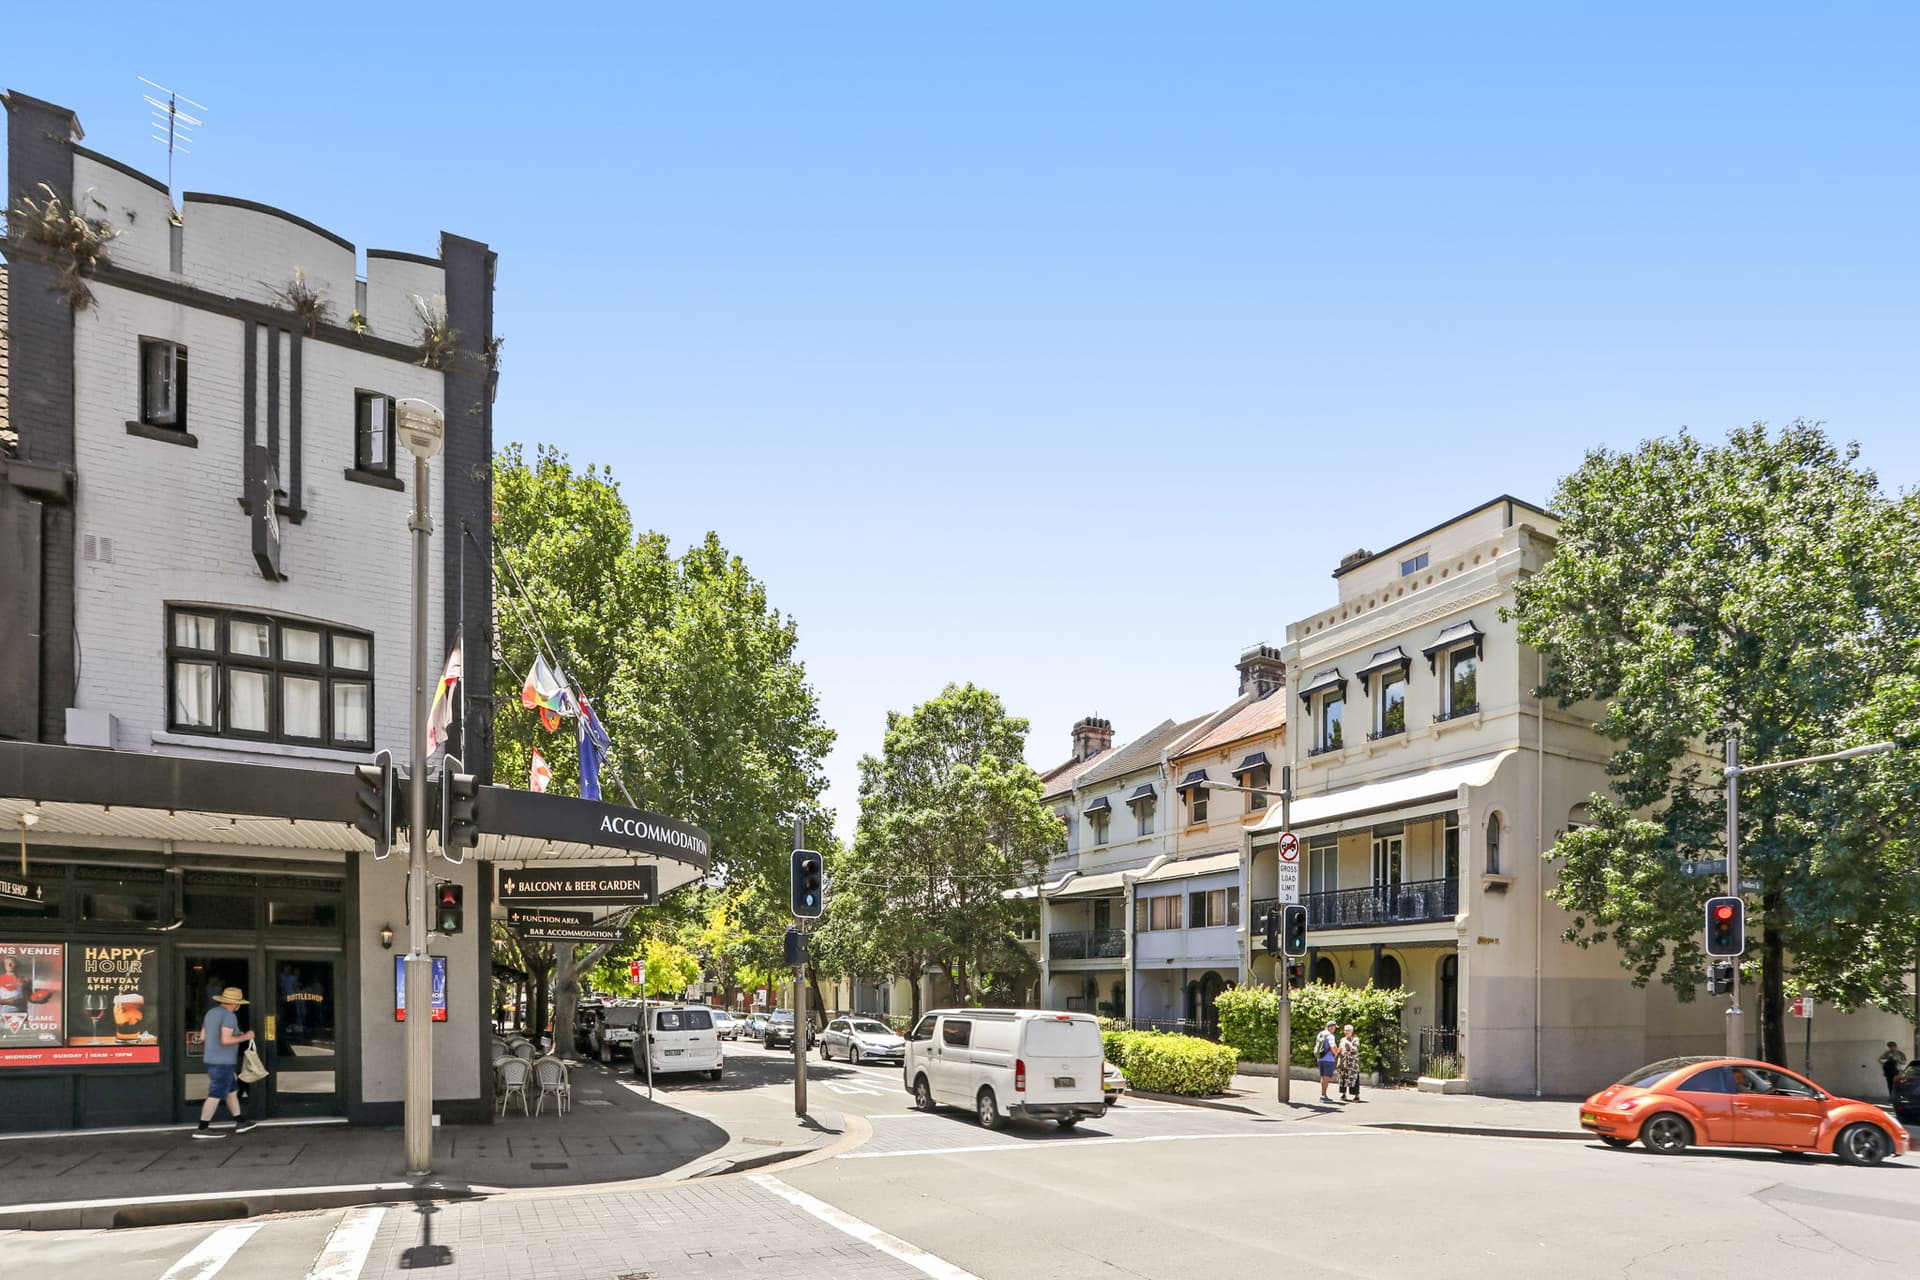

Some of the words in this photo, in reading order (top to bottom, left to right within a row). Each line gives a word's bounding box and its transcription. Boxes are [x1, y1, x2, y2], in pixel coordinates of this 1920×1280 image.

[600, 815, 707, 856] ACCOMMODATION
[11, 883, 28, 897] SHOP
[518, 881, 563, 892] BALCONY
[564, 881, 572, 891] &
[574, 880, 597, 891] BEER
[599, 880, 641, 891] GARDEN
[522, 914, 560, 924] FUNCTION
[562, 917, 580, 925] AREA
[529, 928, 544, 936] BAR
[546, 928, 614, 938] ACCOMMODATION
[19, 947, 61, 956] VENUE
[85, 947, 146, 960] HAPPY
[84, 959, 143, 973] HOUR
[87, 976, 140, 984] EVERYDAY
[118, 984, 139, 992] 6PM
[23, 1023, 57, 1031] LOUD
